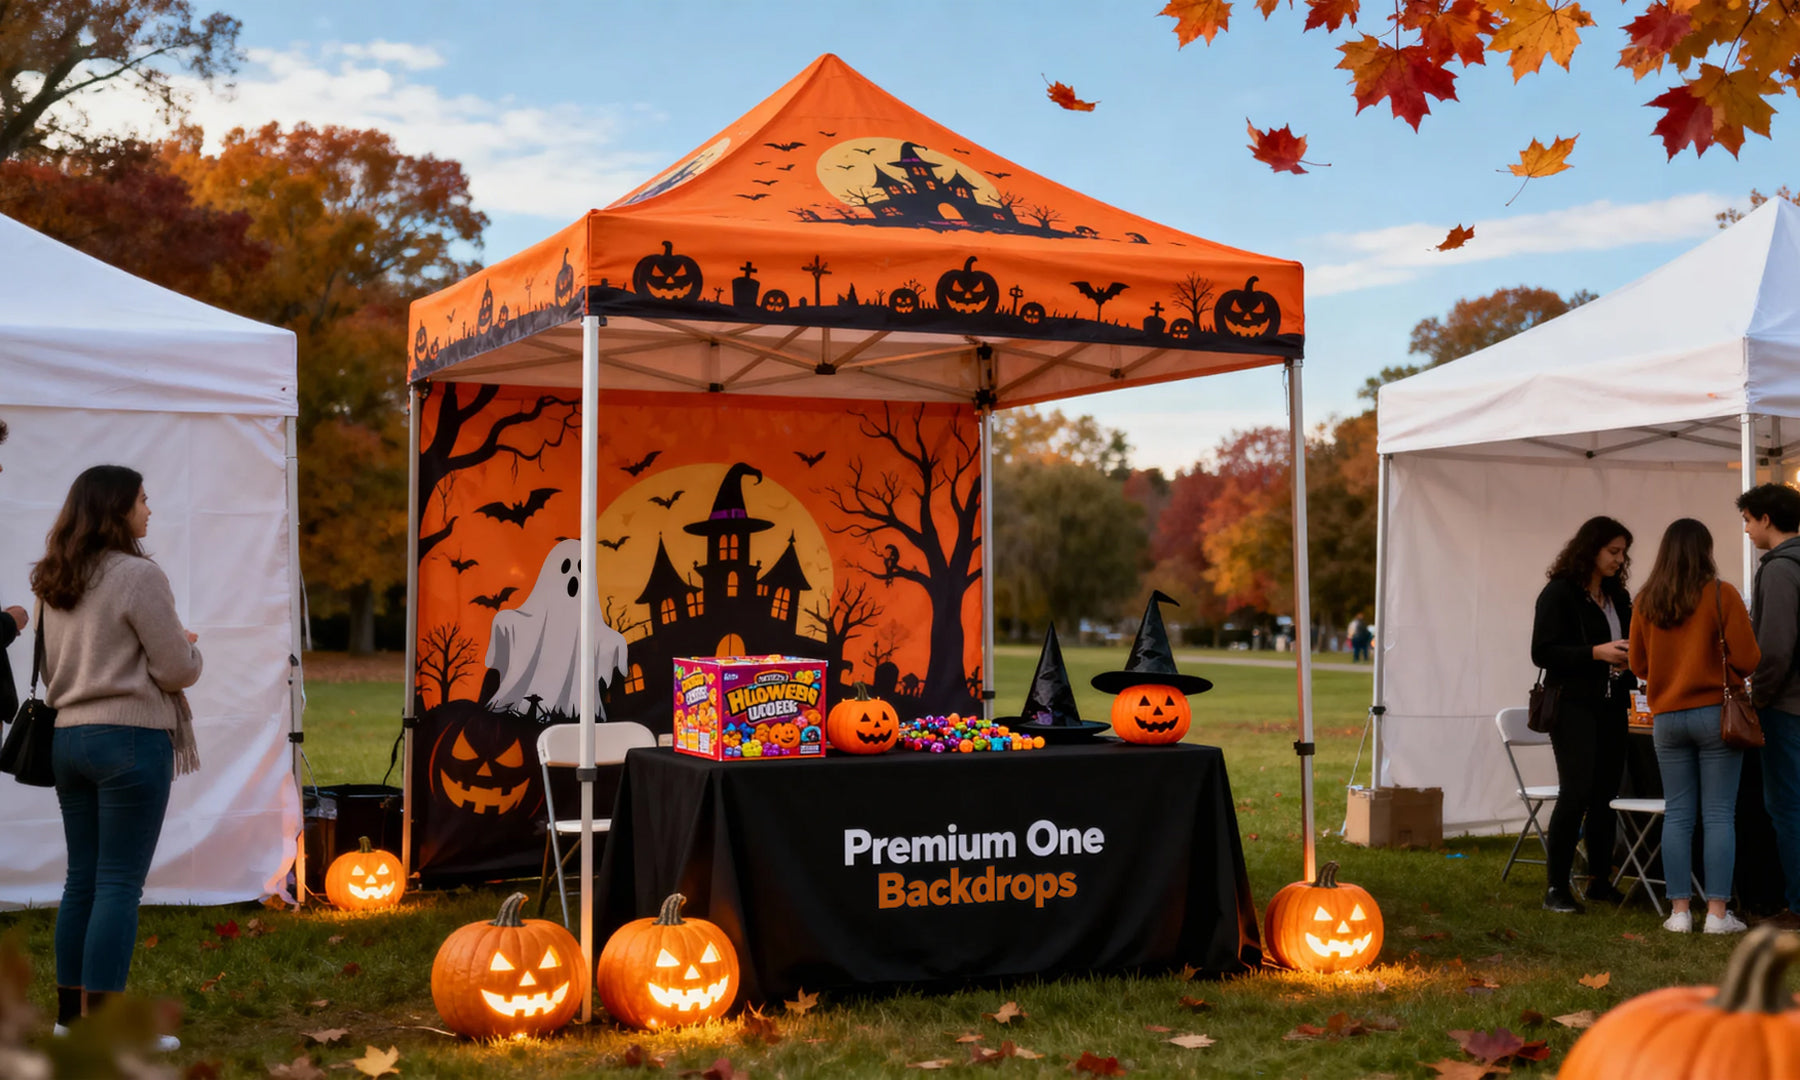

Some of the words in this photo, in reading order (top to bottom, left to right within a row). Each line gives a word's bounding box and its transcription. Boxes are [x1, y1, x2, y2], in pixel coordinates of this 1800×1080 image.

[844, 824, 1016, 866] Premium
[1026, 819, 1105, 856] One
[878, 866, 1078, 909] Backdrops
